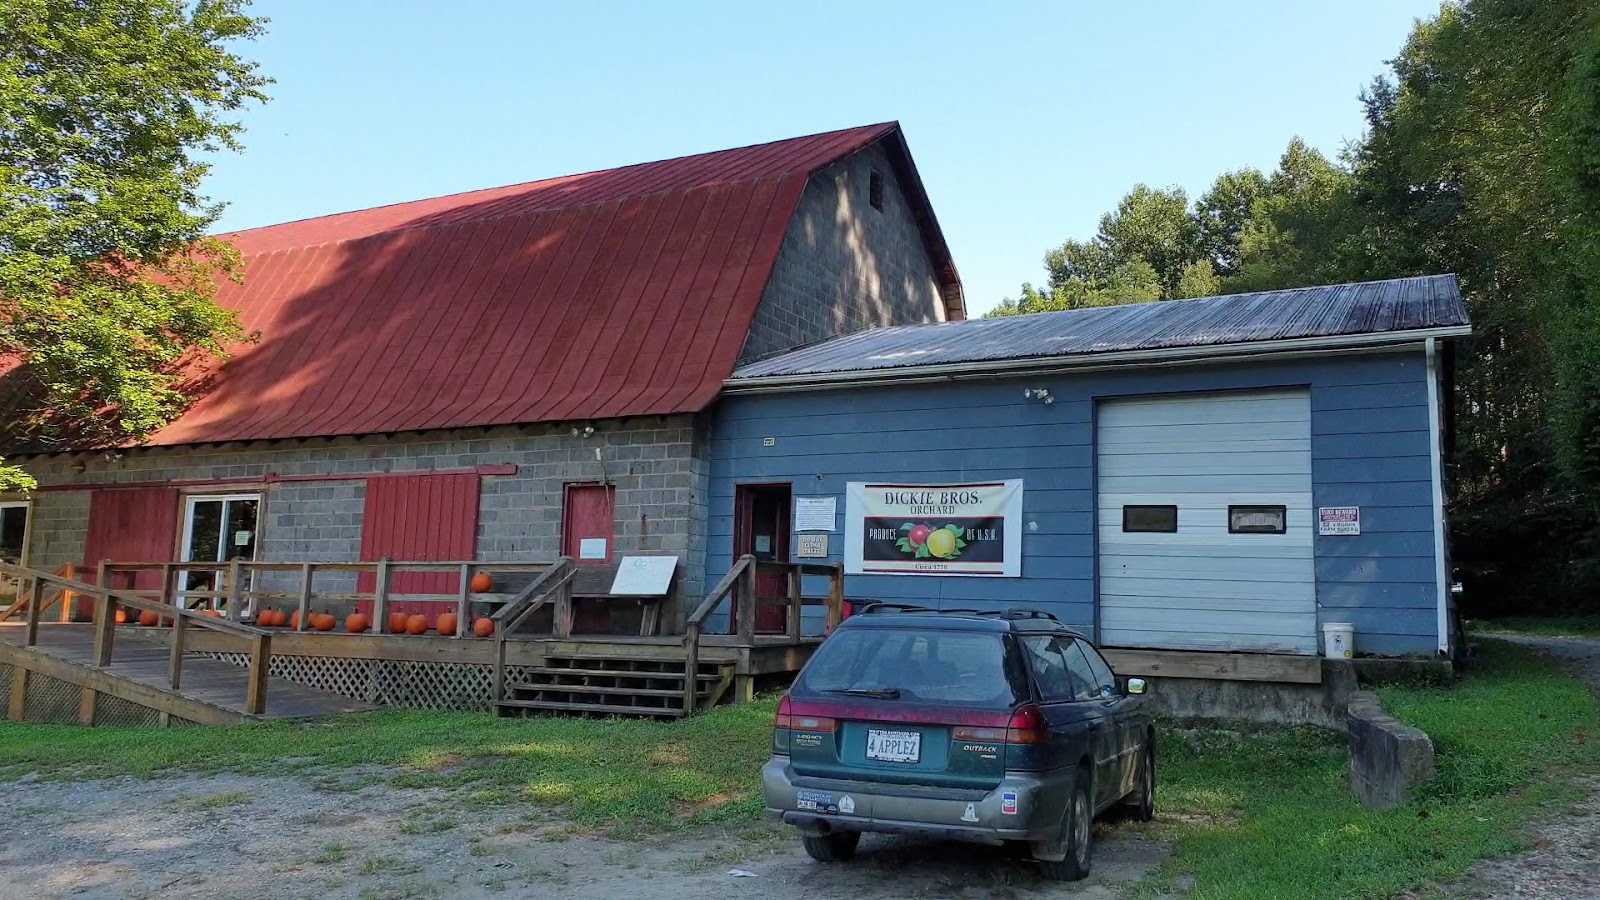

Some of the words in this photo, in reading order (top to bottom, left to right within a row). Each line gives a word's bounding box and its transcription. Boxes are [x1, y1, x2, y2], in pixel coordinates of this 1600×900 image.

[884, 491, 935, 505] DICKIE
[940, 490, 983, 504] BROS.
[910, 505, 956, 515] ORCHARD
[868, 528, 897, 541] PRODUCE
[966, 528, 975, 541] OF
[977, 528, 998, 541] U.S.A.
[868, 738, 876, 752] 4
[878, 739, 916, 756] APPLEZ
